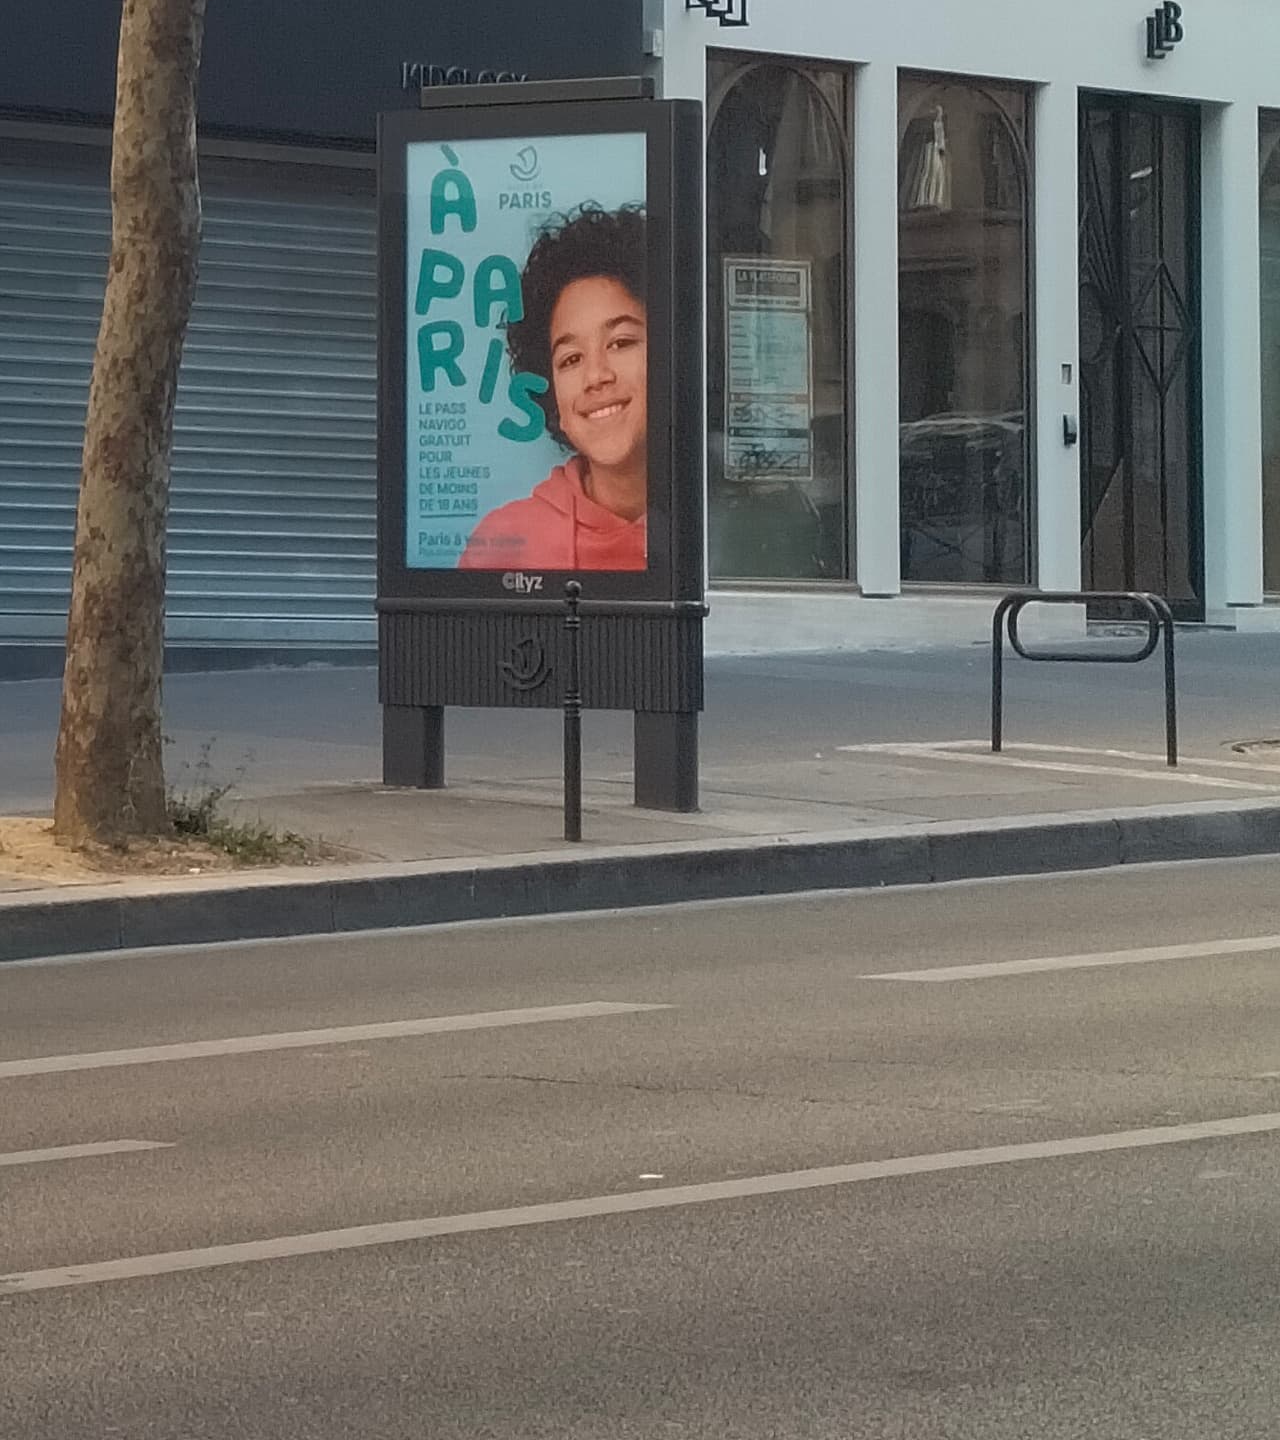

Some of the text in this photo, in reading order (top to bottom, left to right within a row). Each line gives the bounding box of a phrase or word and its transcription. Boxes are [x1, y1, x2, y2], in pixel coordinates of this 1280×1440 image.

[1146, 0, 1184, 60] LLB
[430, 144, 477, 235] À
[499, 191, 552, 210] PARIS
[419, 402, 466, 415] LE PASS
[419, 419, 466, 431] NAVIGO
[419, 434, 471, 447] GRATUIT
[419, 451, 452, 463] POUR
[419, 466, 490, 479] LES JEUNES
[419, 482, 477, 495] DE MOINS
[419, 499, 434, 511] DE
[452, 498, 477, 510] ANS
[418, 531, 451, 546] Paris
